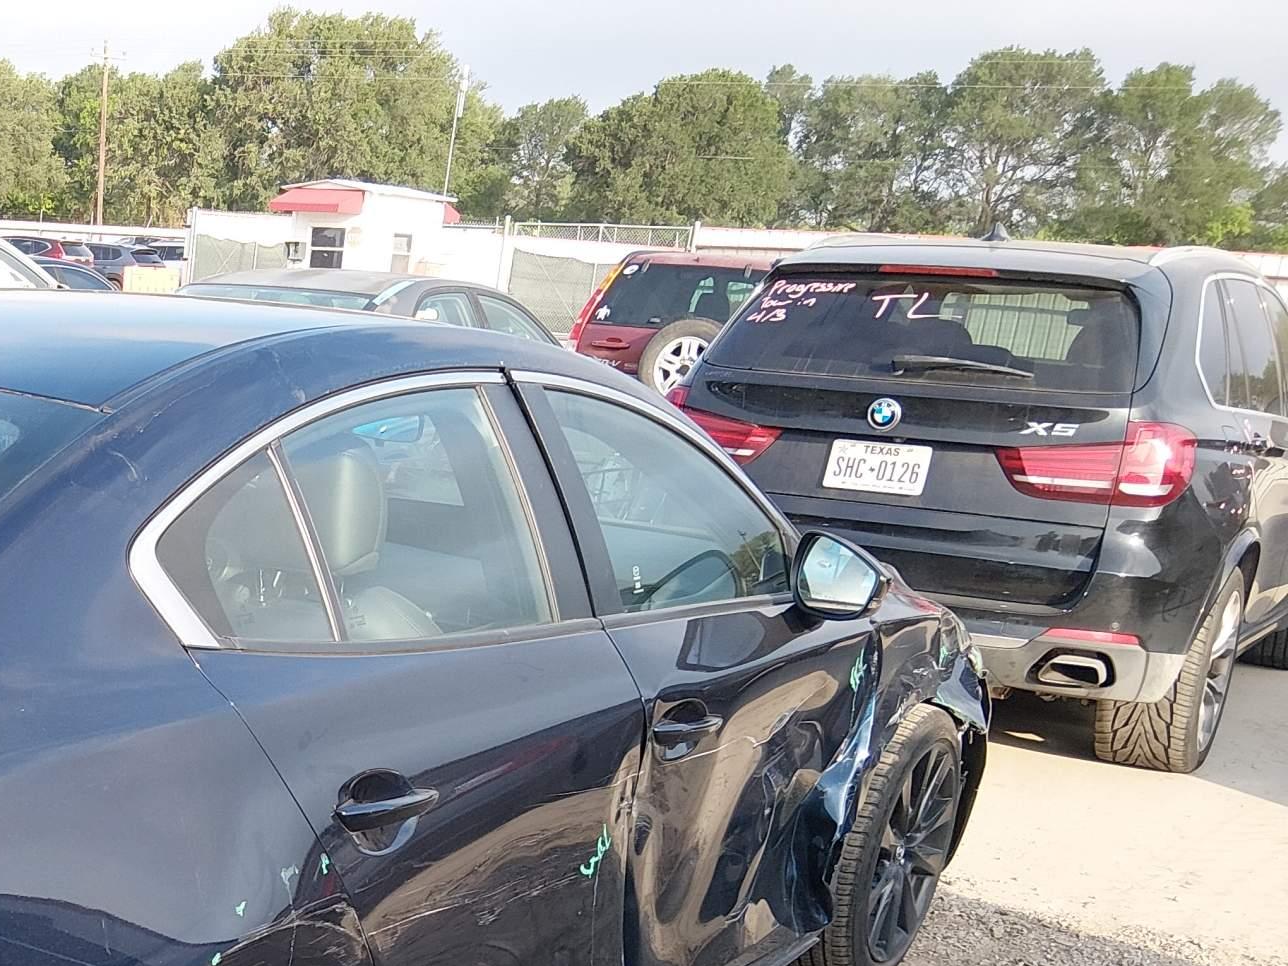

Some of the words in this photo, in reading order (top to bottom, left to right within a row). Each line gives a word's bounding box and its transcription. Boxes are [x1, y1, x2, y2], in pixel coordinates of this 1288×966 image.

[767, 279, 857, 299] Progressive
[746, 308, 787, 323] 4/3
[1019, 421, 1080, 437] X5
[863, 445, 901, 457] TEXAS
